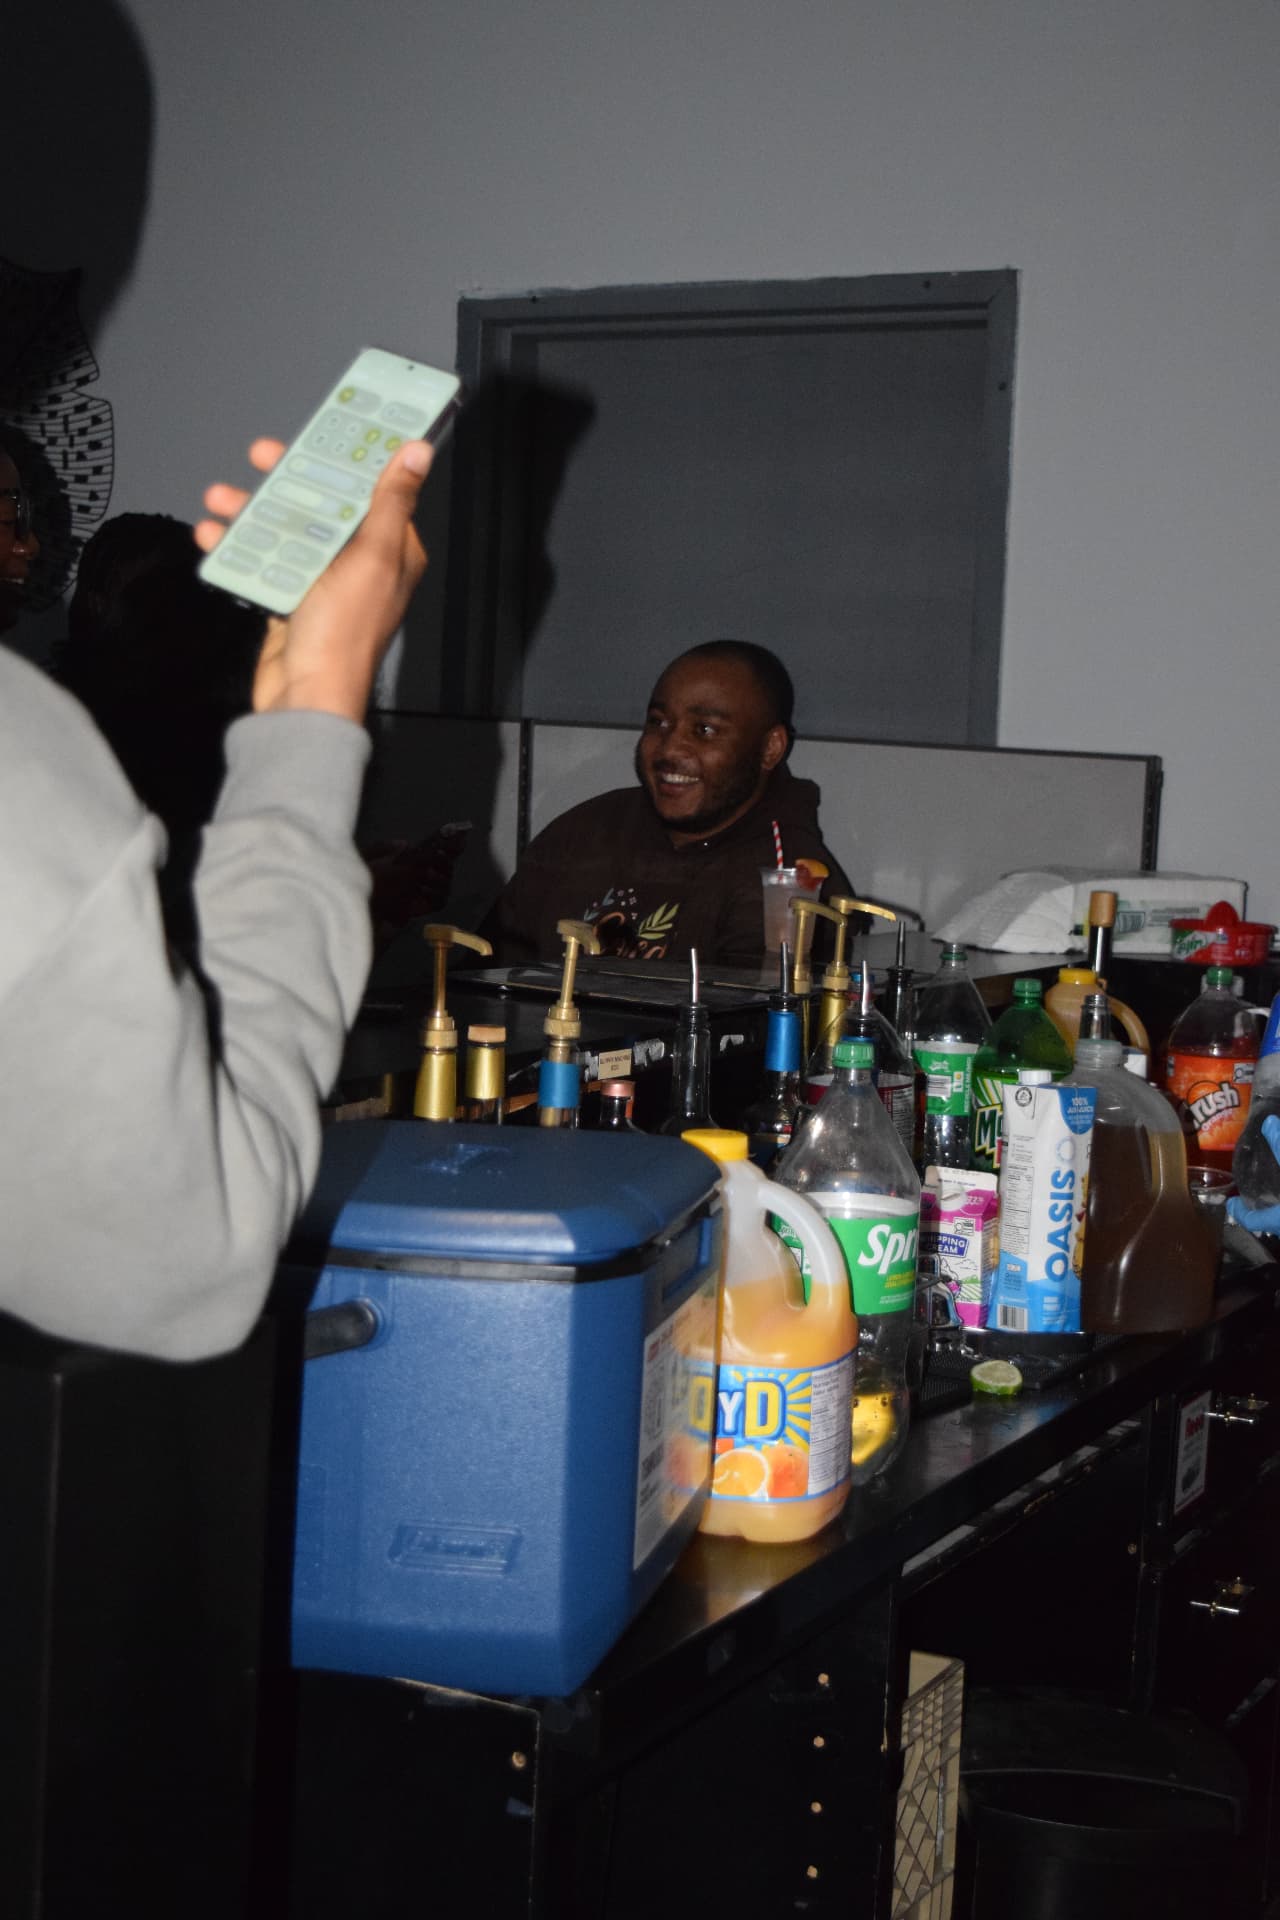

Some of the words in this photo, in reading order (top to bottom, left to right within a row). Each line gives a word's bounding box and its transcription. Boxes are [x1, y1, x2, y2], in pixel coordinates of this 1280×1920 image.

[976, 1107, 1003, 1153] M
[1188, 1082, 1240, 1130] rush
[1044, 1169, 1075, 1282] OASIS
